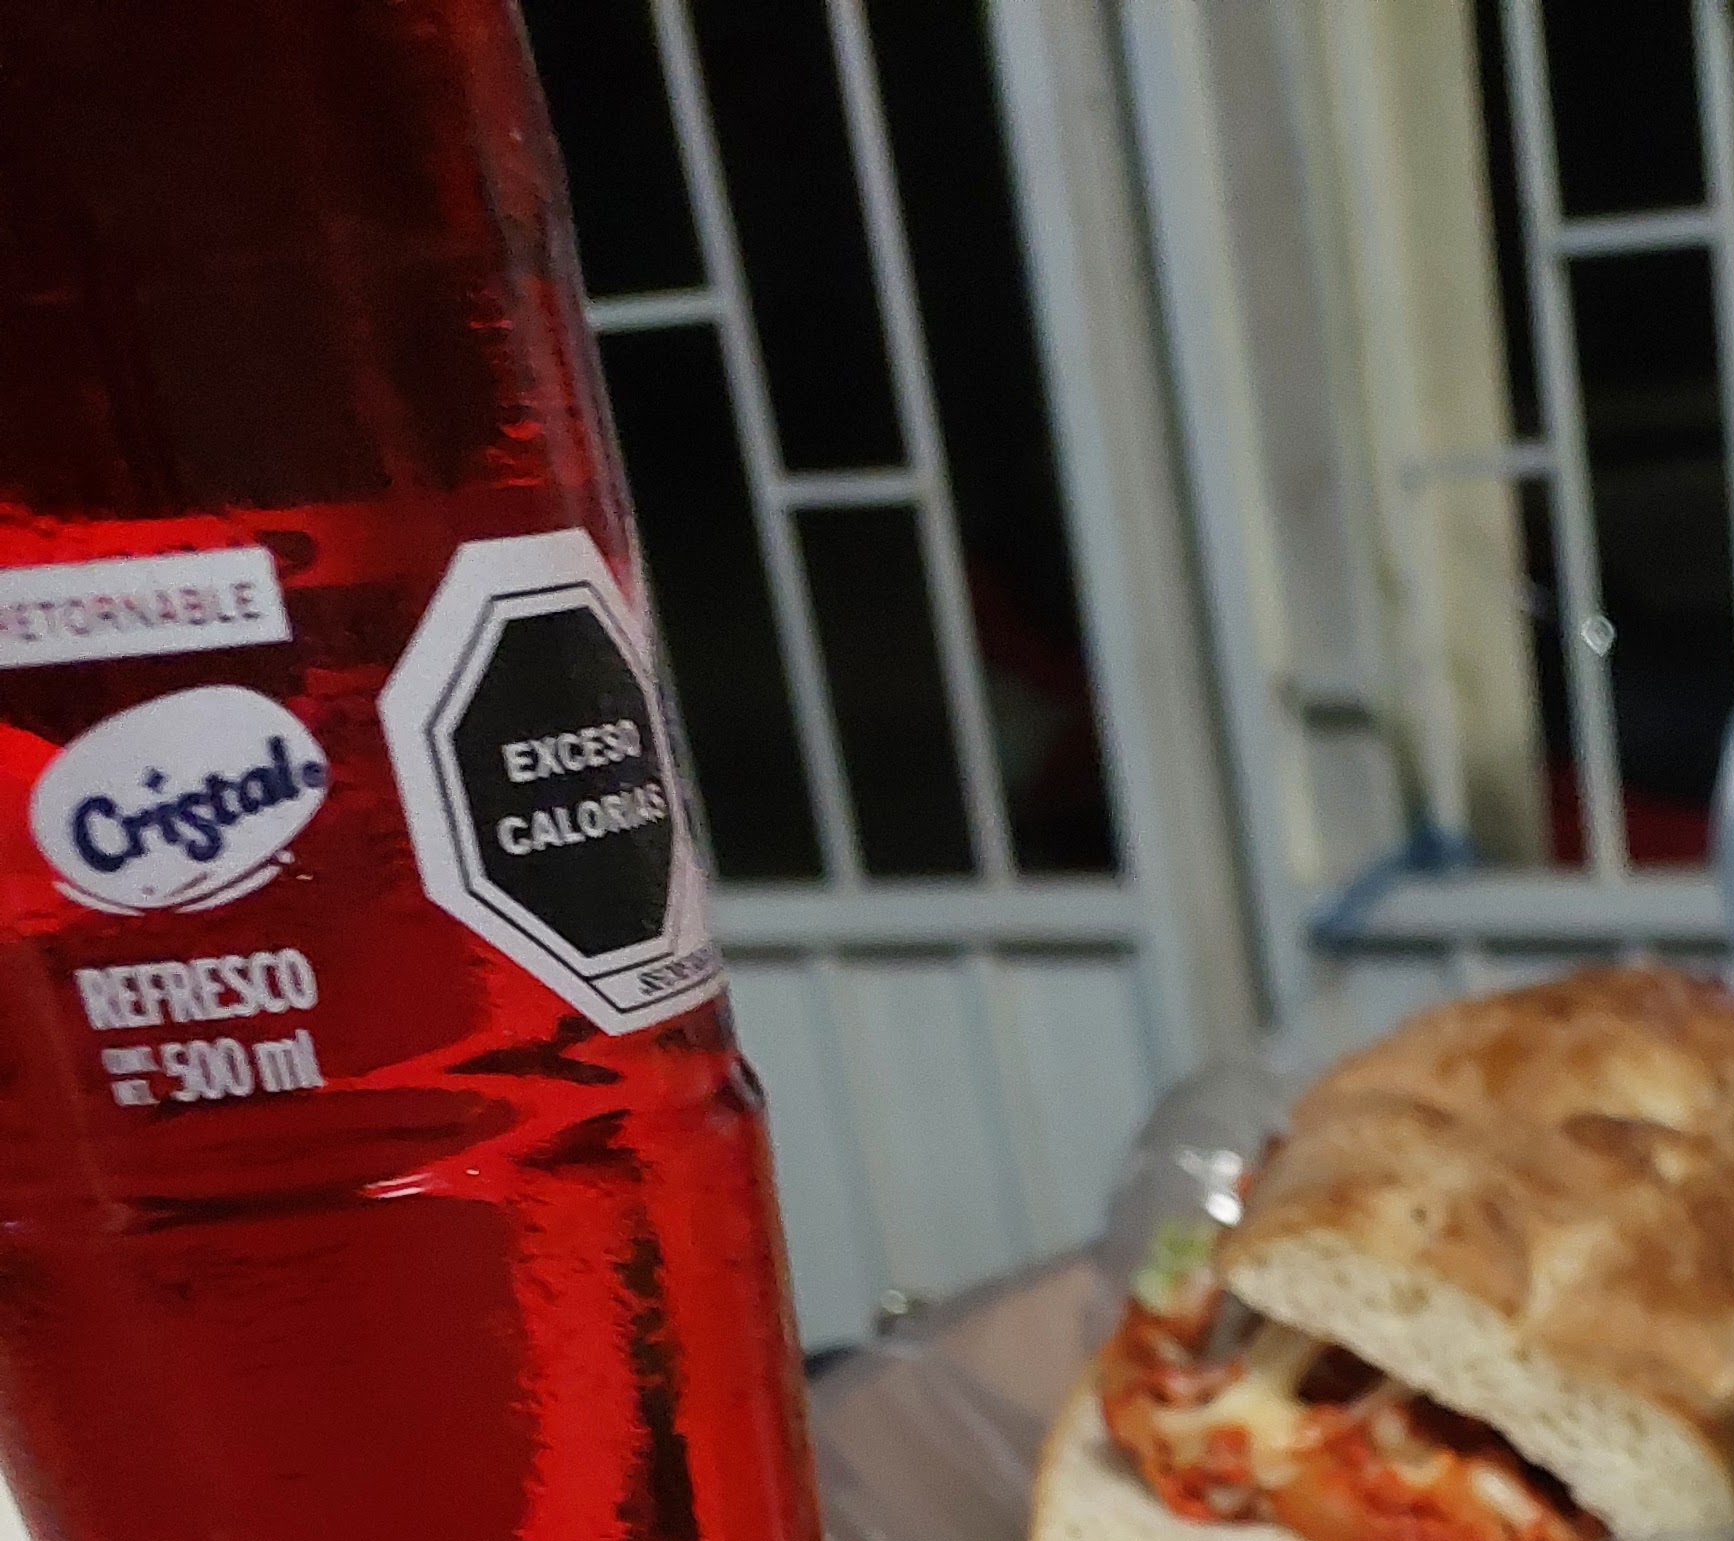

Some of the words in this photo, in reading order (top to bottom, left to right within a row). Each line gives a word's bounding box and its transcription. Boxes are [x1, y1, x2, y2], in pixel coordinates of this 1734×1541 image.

[501, 719, 642, 783] EXCESO
[72, 735, 300, 872] Cristal
[75, 948, 319, 1031] REFRESCO
[160, 1037, 254, 1102] 500
[252, 1029, 326, 1092] ml
